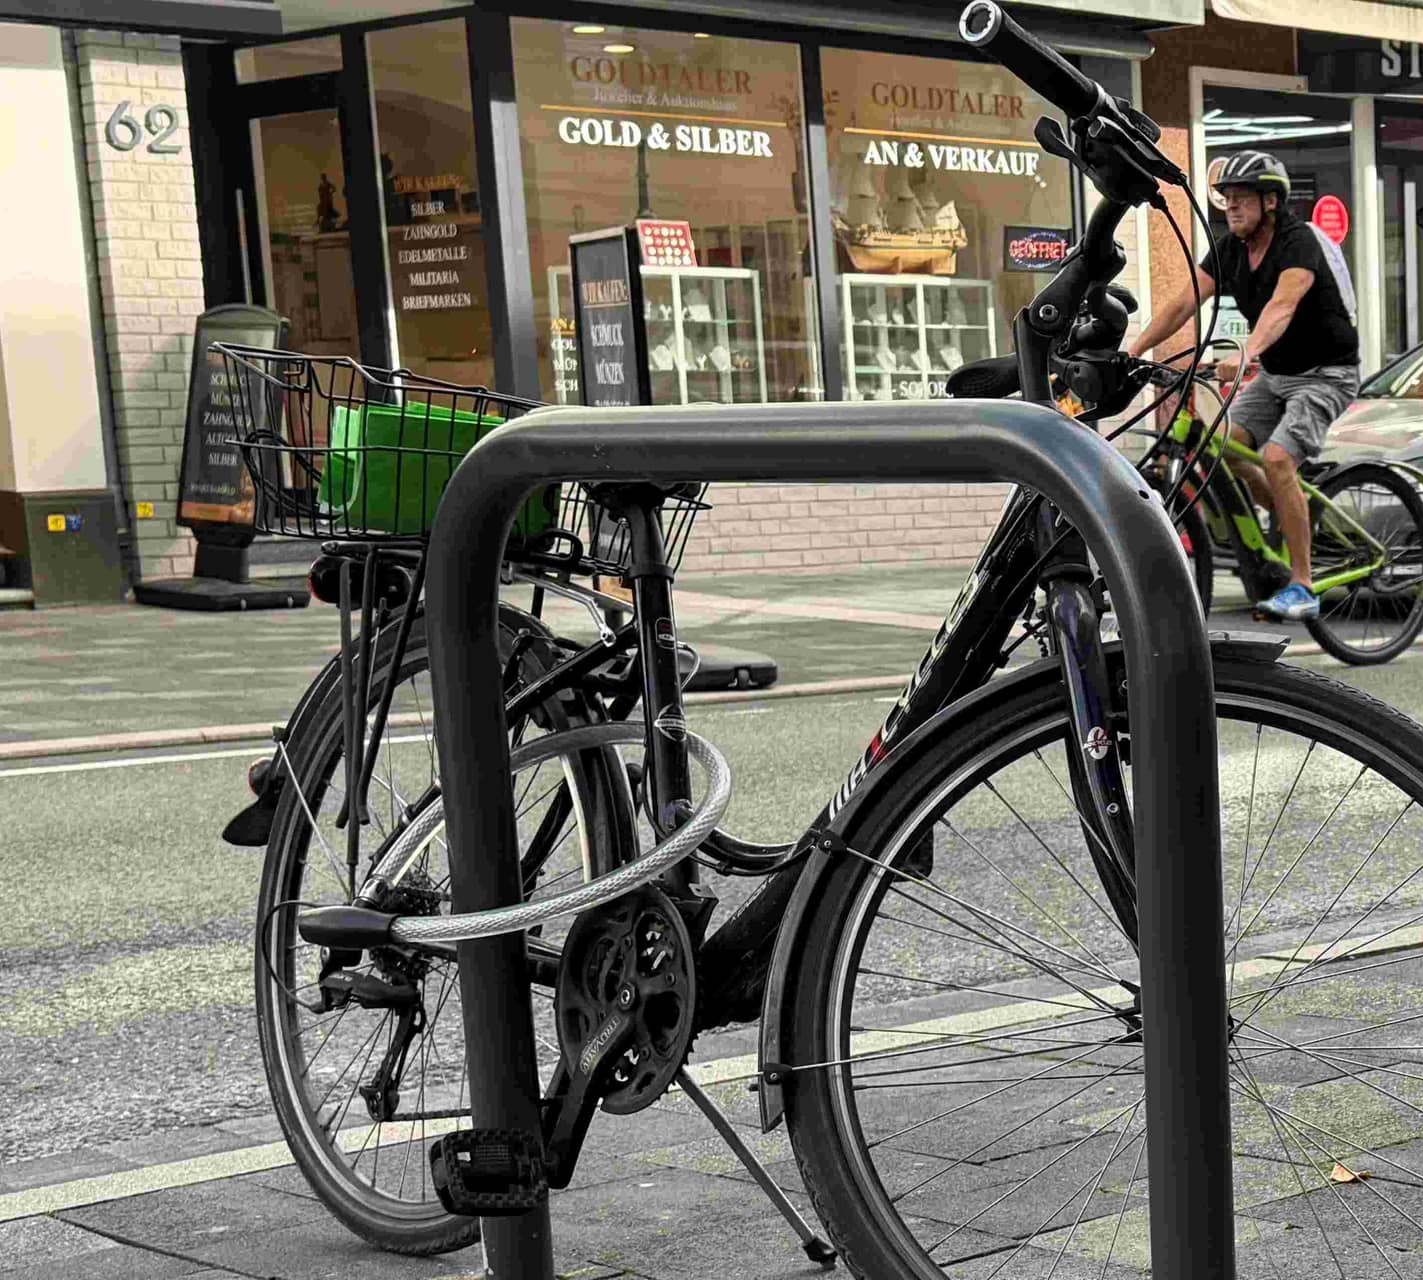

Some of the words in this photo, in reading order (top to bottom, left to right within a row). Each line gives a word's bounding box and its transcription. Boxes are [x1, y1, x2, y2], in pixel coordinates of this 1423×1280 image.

[570, 56, 753, 95] GOLDTALER
[871, 82, 1025, 119] GOLDTALER
[103, 100, 183, 155] 62
[558, 117, 643, 148] GOLD
[647, 122, 672, 151] &
[675, 124, 774, 158] SILBER
[864, 140, 900, 167] AN
[903, 141, 925, 169] &
[928, 144, 1040, 177] VERKAUF
[402, 223, 458, 241] ZAHNGOLD
[398, 246, 469, 265] EDELMETALLE
[1008, 239, 1069, 260] GEÖFFNET
[409, 270, 460, 287] MILITARIA
[402, 293, 472, 311] BRIEFMARKEN
